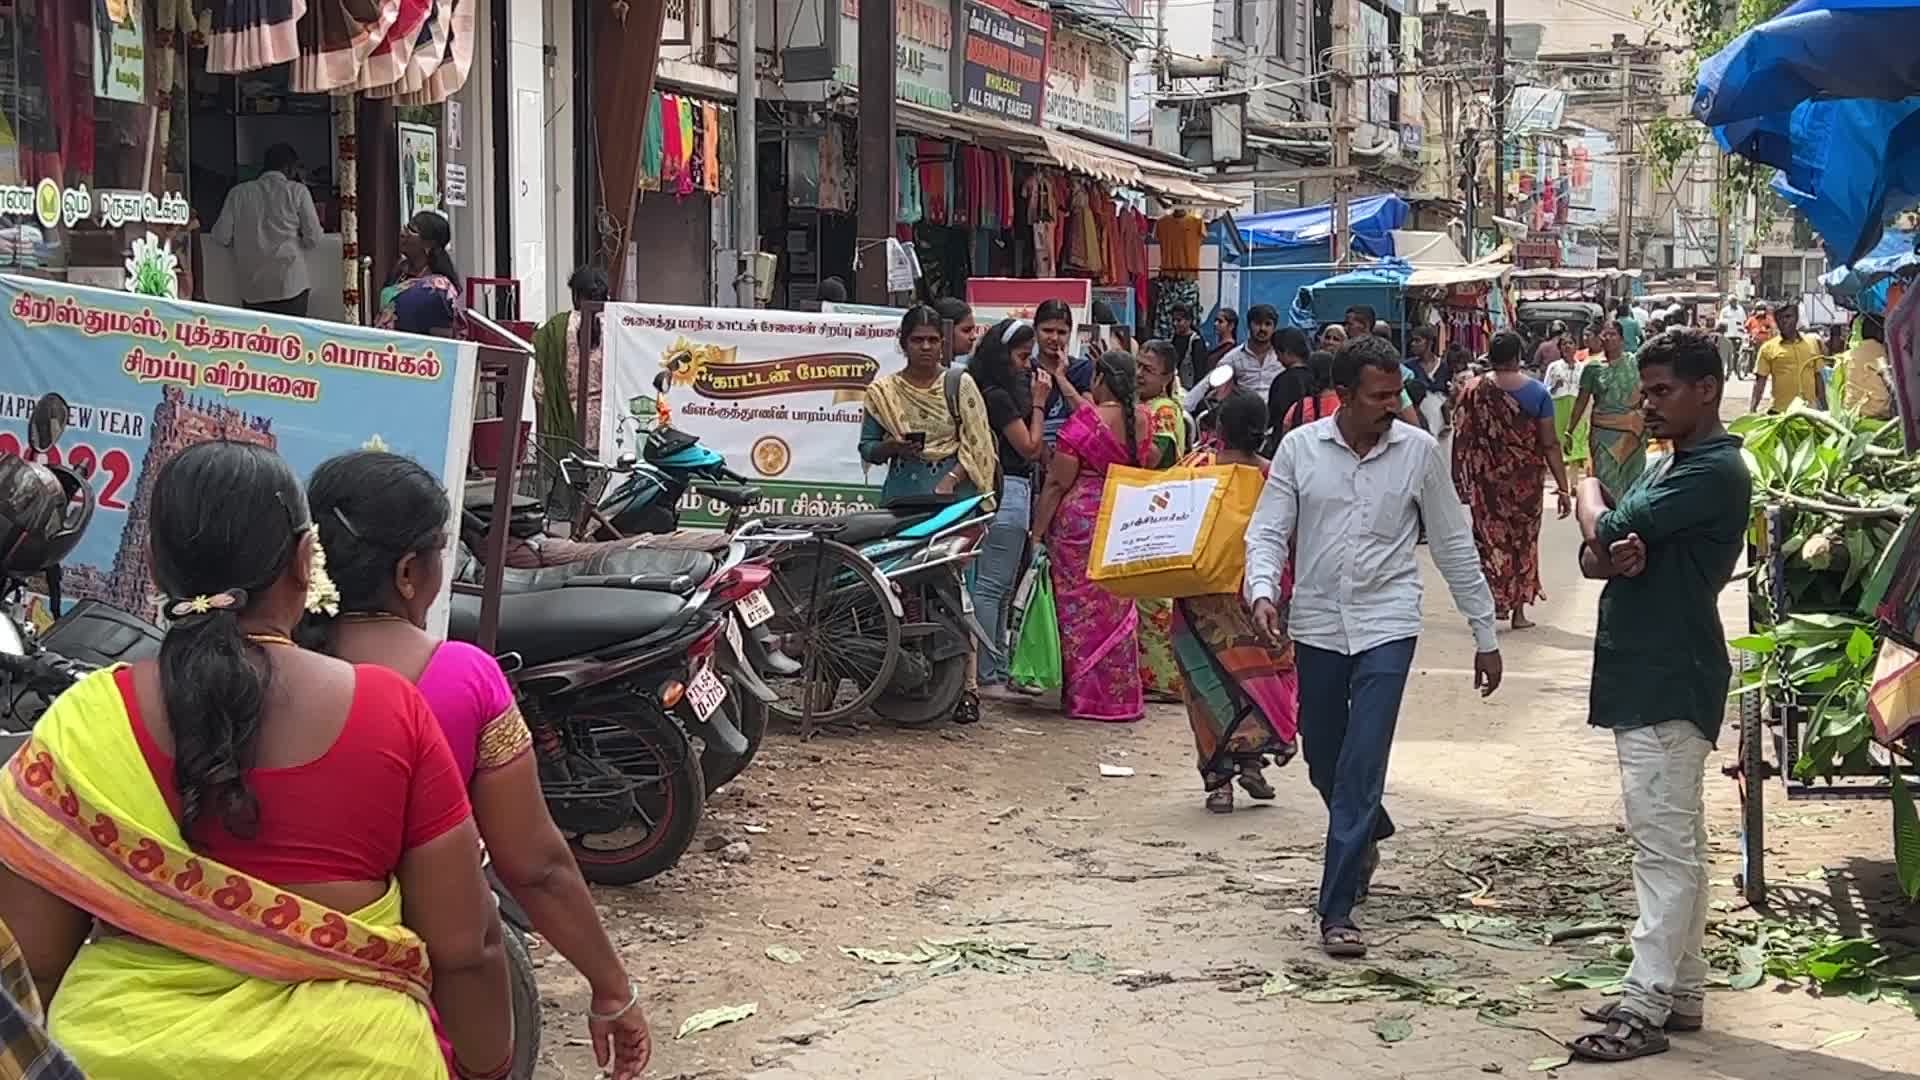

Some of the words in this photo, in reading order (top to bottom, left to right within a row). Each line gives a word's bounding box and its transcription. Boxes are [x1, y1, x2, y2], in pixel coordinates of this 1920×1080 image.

[985, 71, 1021, 97] WHOLESALE
[967, 87, 983, 106] ALL
[983, 91, 1007, 113] FANCY
[1007, 98, 1033, 120] SAREES
[143, 192, 189, 221] டெக்ஸ்
[12, 292, 168, 340] கிறிஸ்துமஸ்,
[321, 342, 441, 378] பொங்கல்
[622, 314, 676, 331] அனைத்து
[716, 317, 758, 333] காட்டன்
[760, 320, 817, 336] சேலைகள்
[819, 322, 852, 340] சிறப்பு
[124, 348, 196, 386] சிறப்பு
[203, 361, 318, 400] விற்பனை
[0, 394, 36, 419] APP
[66, 405, 93, 429] EW
[99, 410, 144, 437] YEAR
[676, 485, 703, 511] ம்
[791, 491, 877, 518] சில்க்ஸ்
